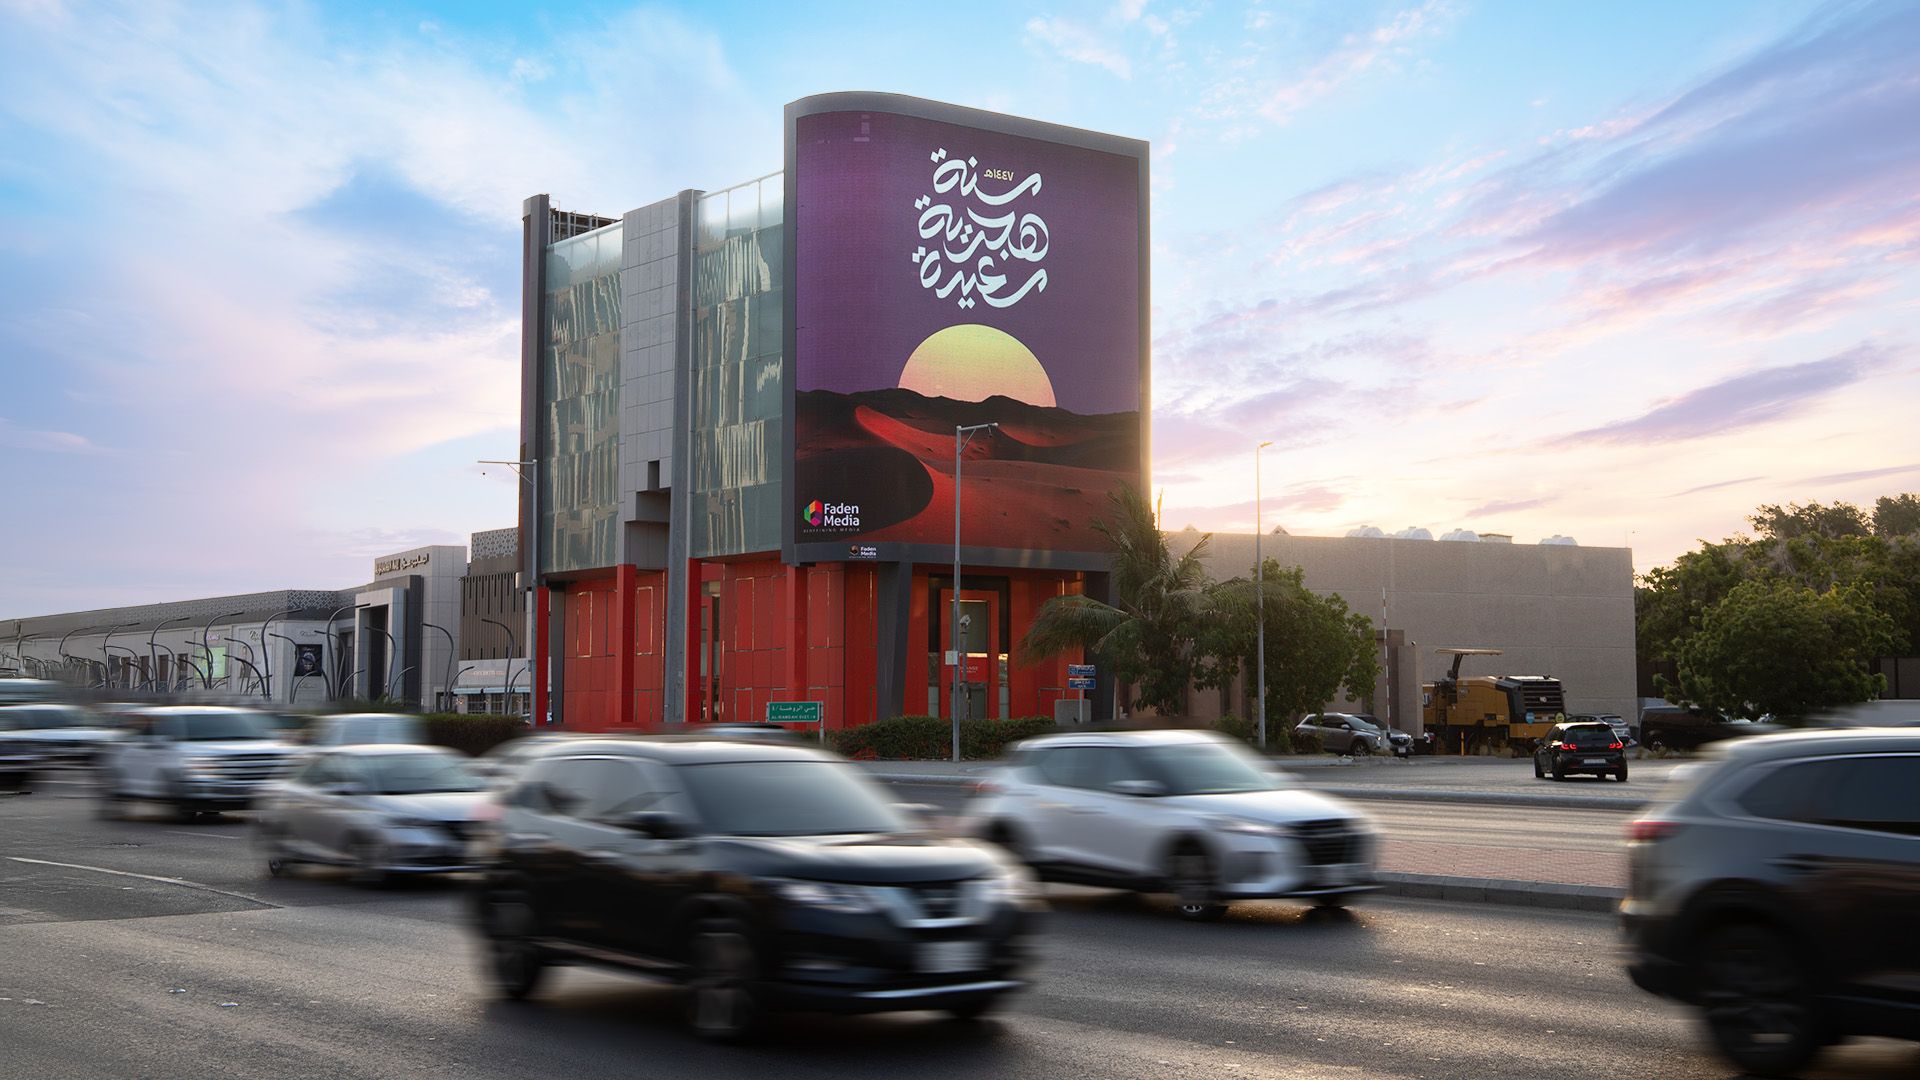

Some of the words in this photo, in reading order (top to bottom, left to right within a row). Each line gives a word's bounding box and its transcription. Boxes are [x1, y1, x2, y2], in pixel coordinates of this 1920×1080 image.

[930, 147, 1042, 205] سنة
[914, 194, 1049, 263] هجرية
[912, 246, 1048, 309] سعيدة
[824, 502, 859, 514] Faden
[824, 514, 860, 526] Media
